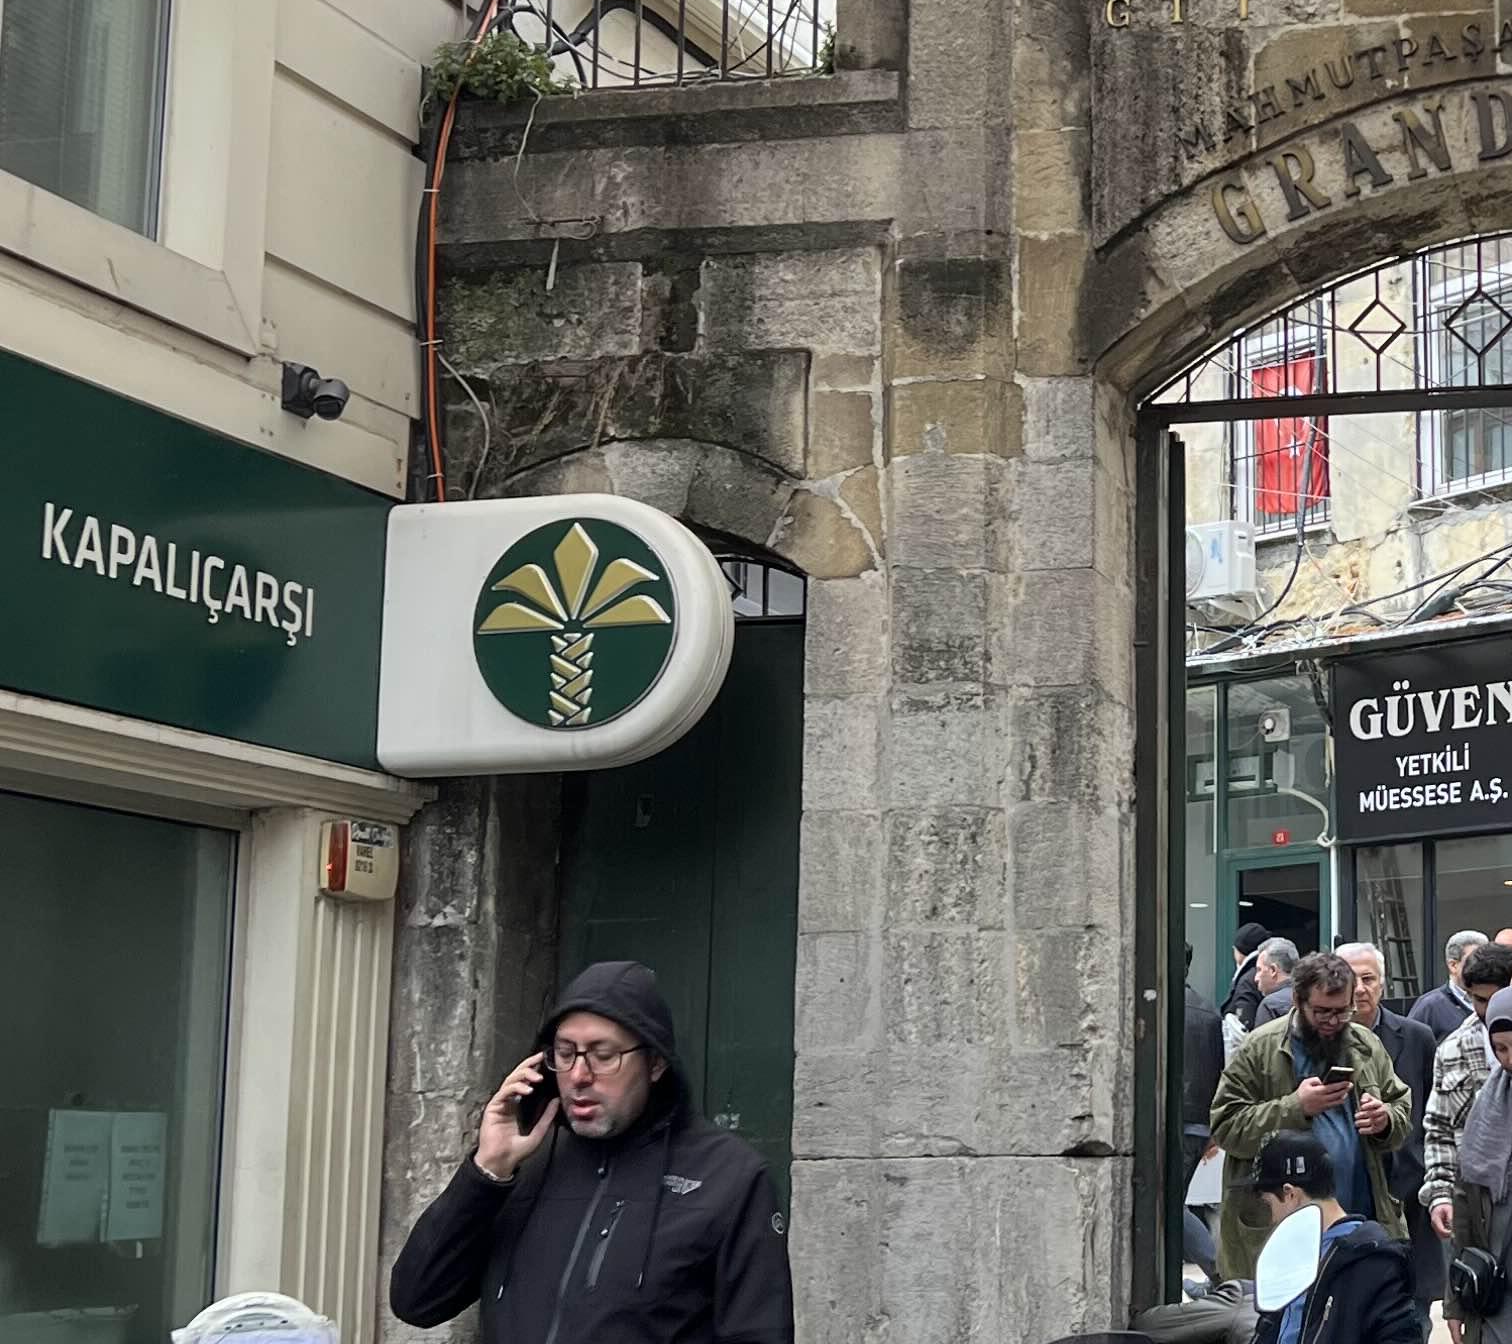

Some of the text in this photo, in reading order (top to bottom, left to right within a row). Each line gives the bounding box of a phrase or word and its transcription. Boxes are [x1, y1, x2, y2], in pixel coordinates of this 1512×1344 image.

[41, 501, 316, 647] KAPALIÇARŞI
[1395, 742, 1471, 778] YETKİLİ
[1358, 777, 1509, 814] MÜESSESE A.Ş.
